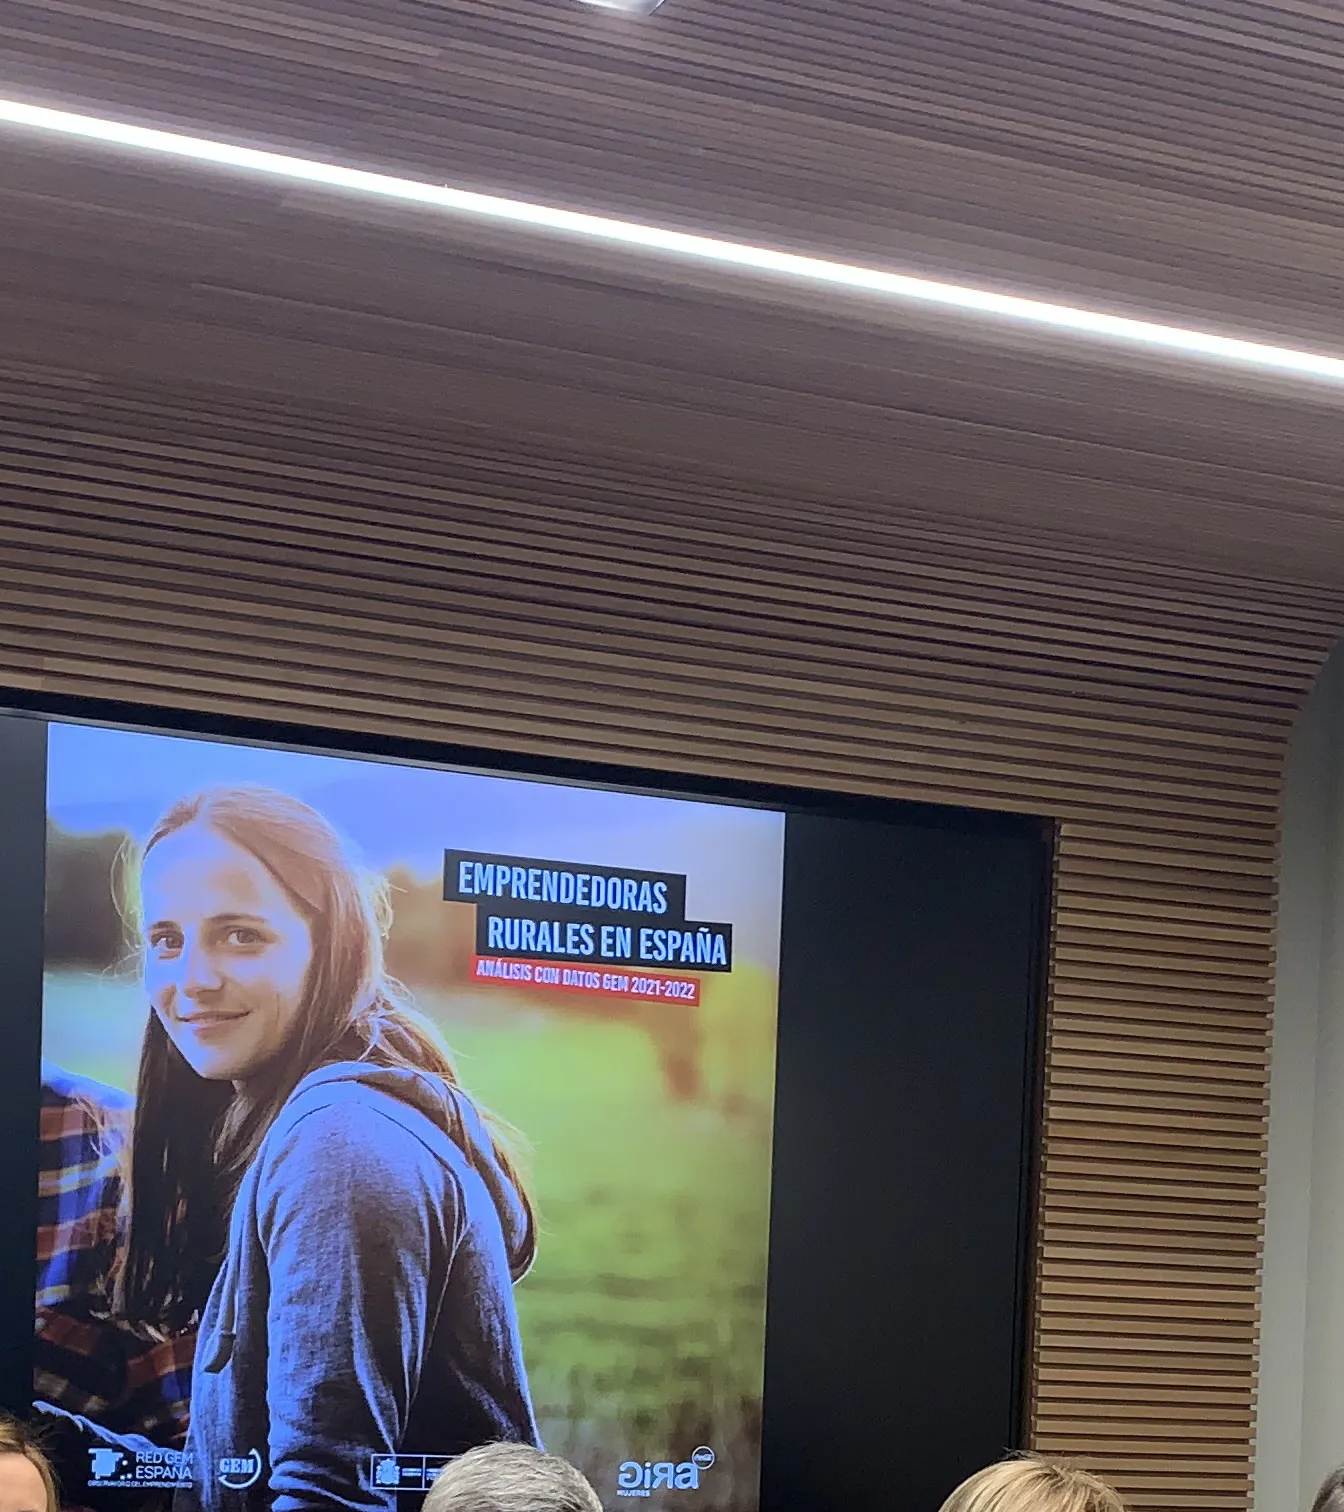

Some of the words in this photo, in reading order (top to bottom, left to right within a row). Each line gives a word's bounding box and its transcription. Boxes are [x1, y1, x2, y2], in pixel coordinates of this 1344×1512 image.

[458, 860, 668, 914] EMPRENDEDORAS
[487, 916, 595, 956] RURALES
[600, 925, 632, 958] EN
[639, 926, 728, 966] ESPAÑA
[476, 957, 532, 981] ANÁLISIS
[534, 967, 560, 983] CON
[562, 968, 600, 989] DATOS
[602, 973, 630, 992] GEM
[631, 976, 696, 1000] 2021-2022
[136, 1450, 163, 1464] RED
[164, 1452, 194, 1465] GEM
[219, 1457, 255, 1474] GEM
[616, 1489, 651, 1497] MUJERES
